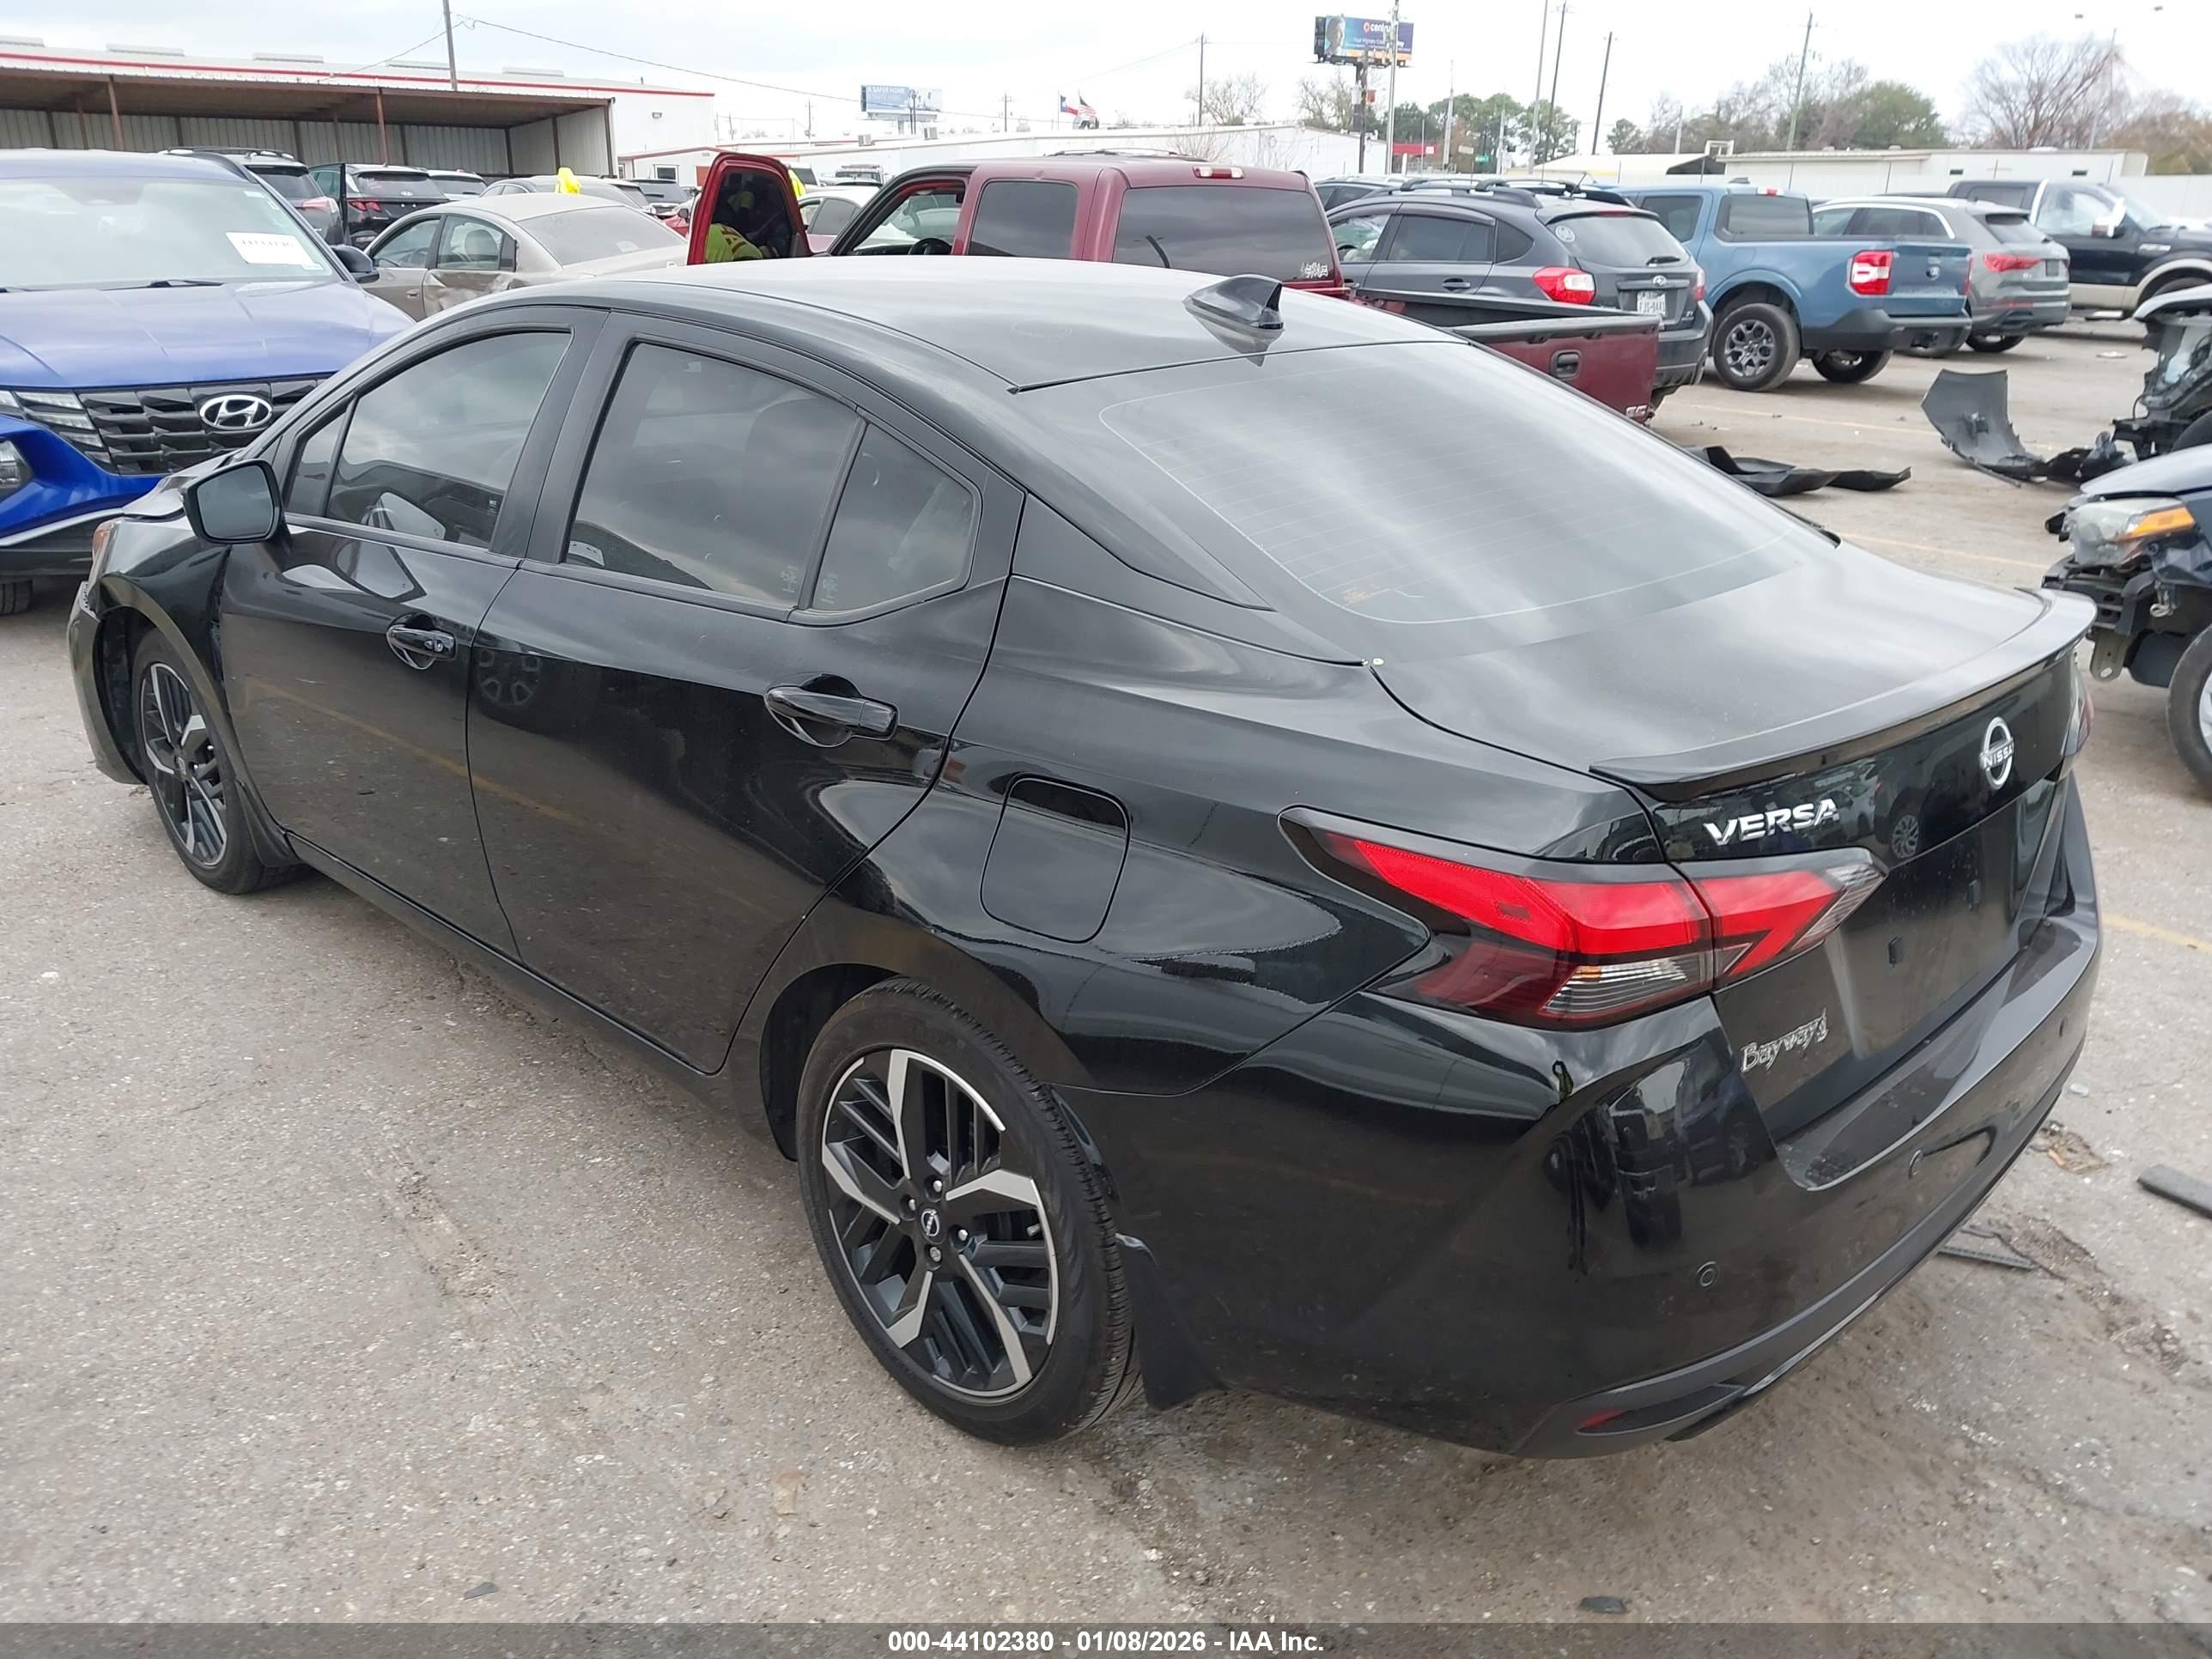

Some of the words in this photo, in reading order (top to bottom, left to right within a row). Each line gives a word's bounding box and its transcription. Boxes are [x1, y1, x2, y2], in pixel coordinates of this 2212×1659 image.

[1370, 22, 1397, 33] centru
[1982, 743, 2014, 769] NISSA
[1703, 798, 1840, 847] VERSA
[1740, 1018, 1820, 1073] Bayway
